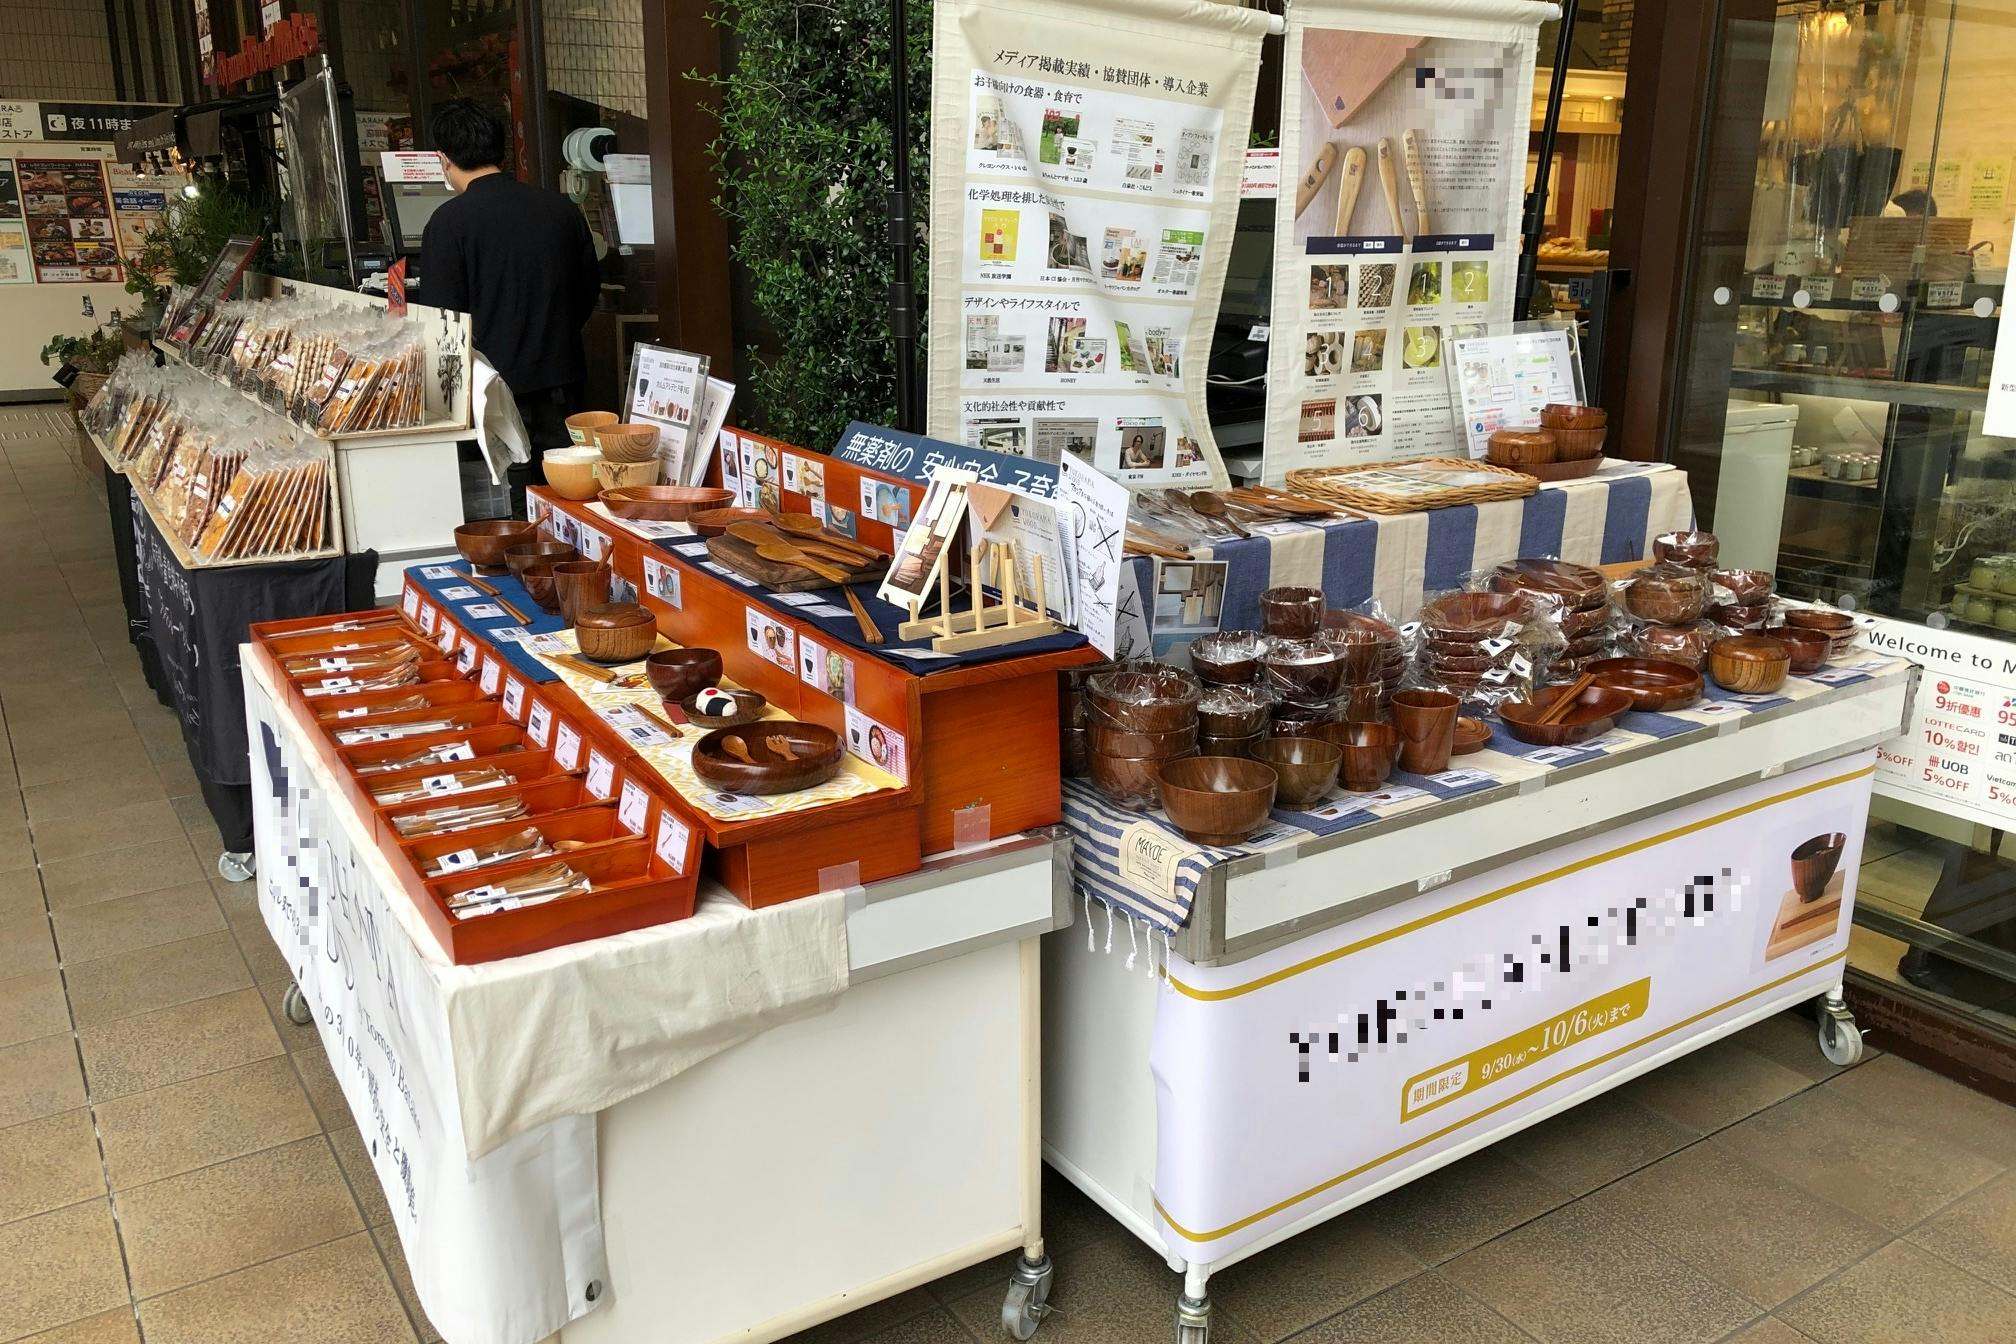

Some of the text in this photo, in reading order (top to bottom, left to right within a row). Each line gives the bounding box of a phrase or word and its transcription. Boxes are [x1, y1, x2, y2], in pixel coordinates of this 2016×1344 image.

[993, 49, 1209, 98] メディア掲載実績・協賛団体・導入企業
[71, 117, 139, 131] 夜11時ま
[1371, 274, 1382, 296] 2
[1464, 271, 1475, 292] 2
[964, 296, 1081, 312] デザインやライフスタイルで
[1319, 343, 1330, 365] 3
[1416, 336, 1427, 358] 3
[964, 400, 1066, 412] 文化的社会性や貢献性で
[1358, 406, 1369, 428] 6
[840, 431, 914, 473] 無薬剤の
[1869, 631, 1962, 664] Welcome
[1972, 653, 1993, 670] to
[1935, 695, 1982, 718] 9折優惠
[1941, 758, 1969, 775] UOB
[1922, 768, 1970, 793] 5%OFF
[1411, 1070, 1463, 1104] 期間限定
